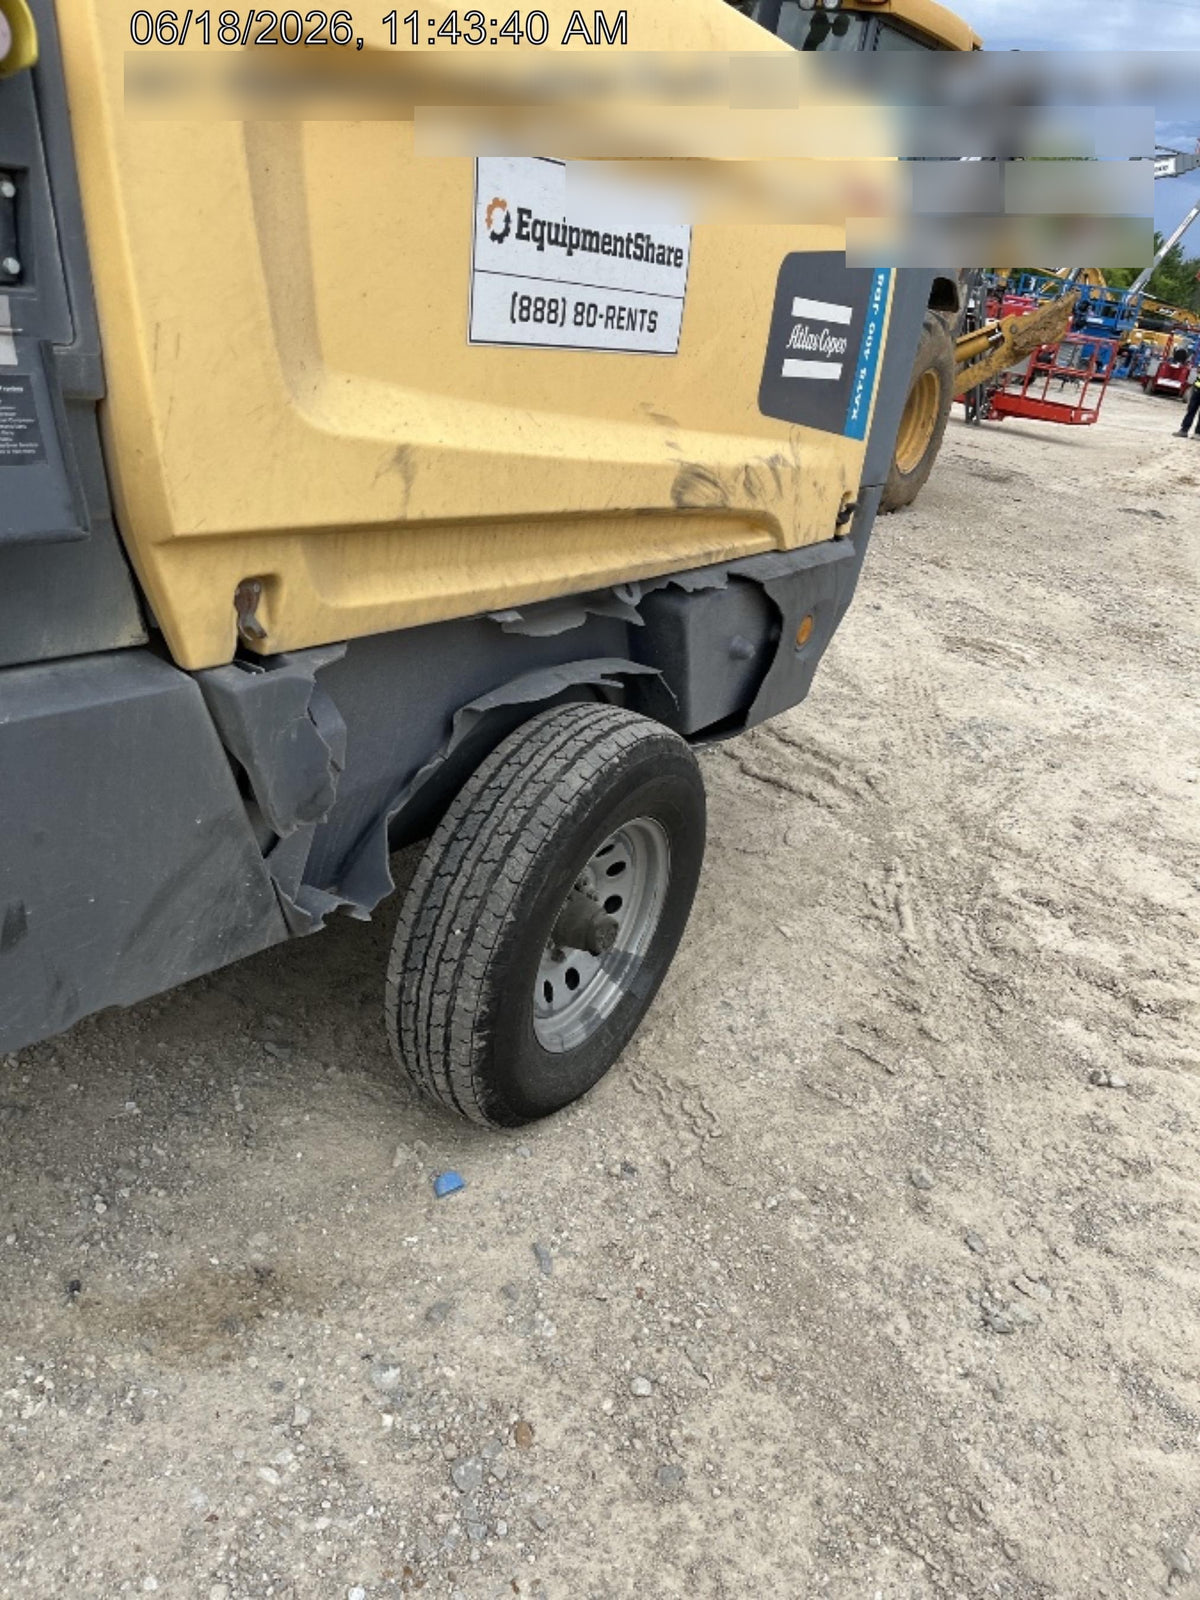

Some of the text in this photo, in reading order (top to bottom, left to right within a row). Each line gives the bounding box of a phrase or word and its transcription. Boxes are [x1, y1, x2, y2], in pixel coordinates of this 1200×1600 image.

[515, 208, 683, 268] EquipmentShare
[510, 291, 658, 332] (888) 80-RENTS
